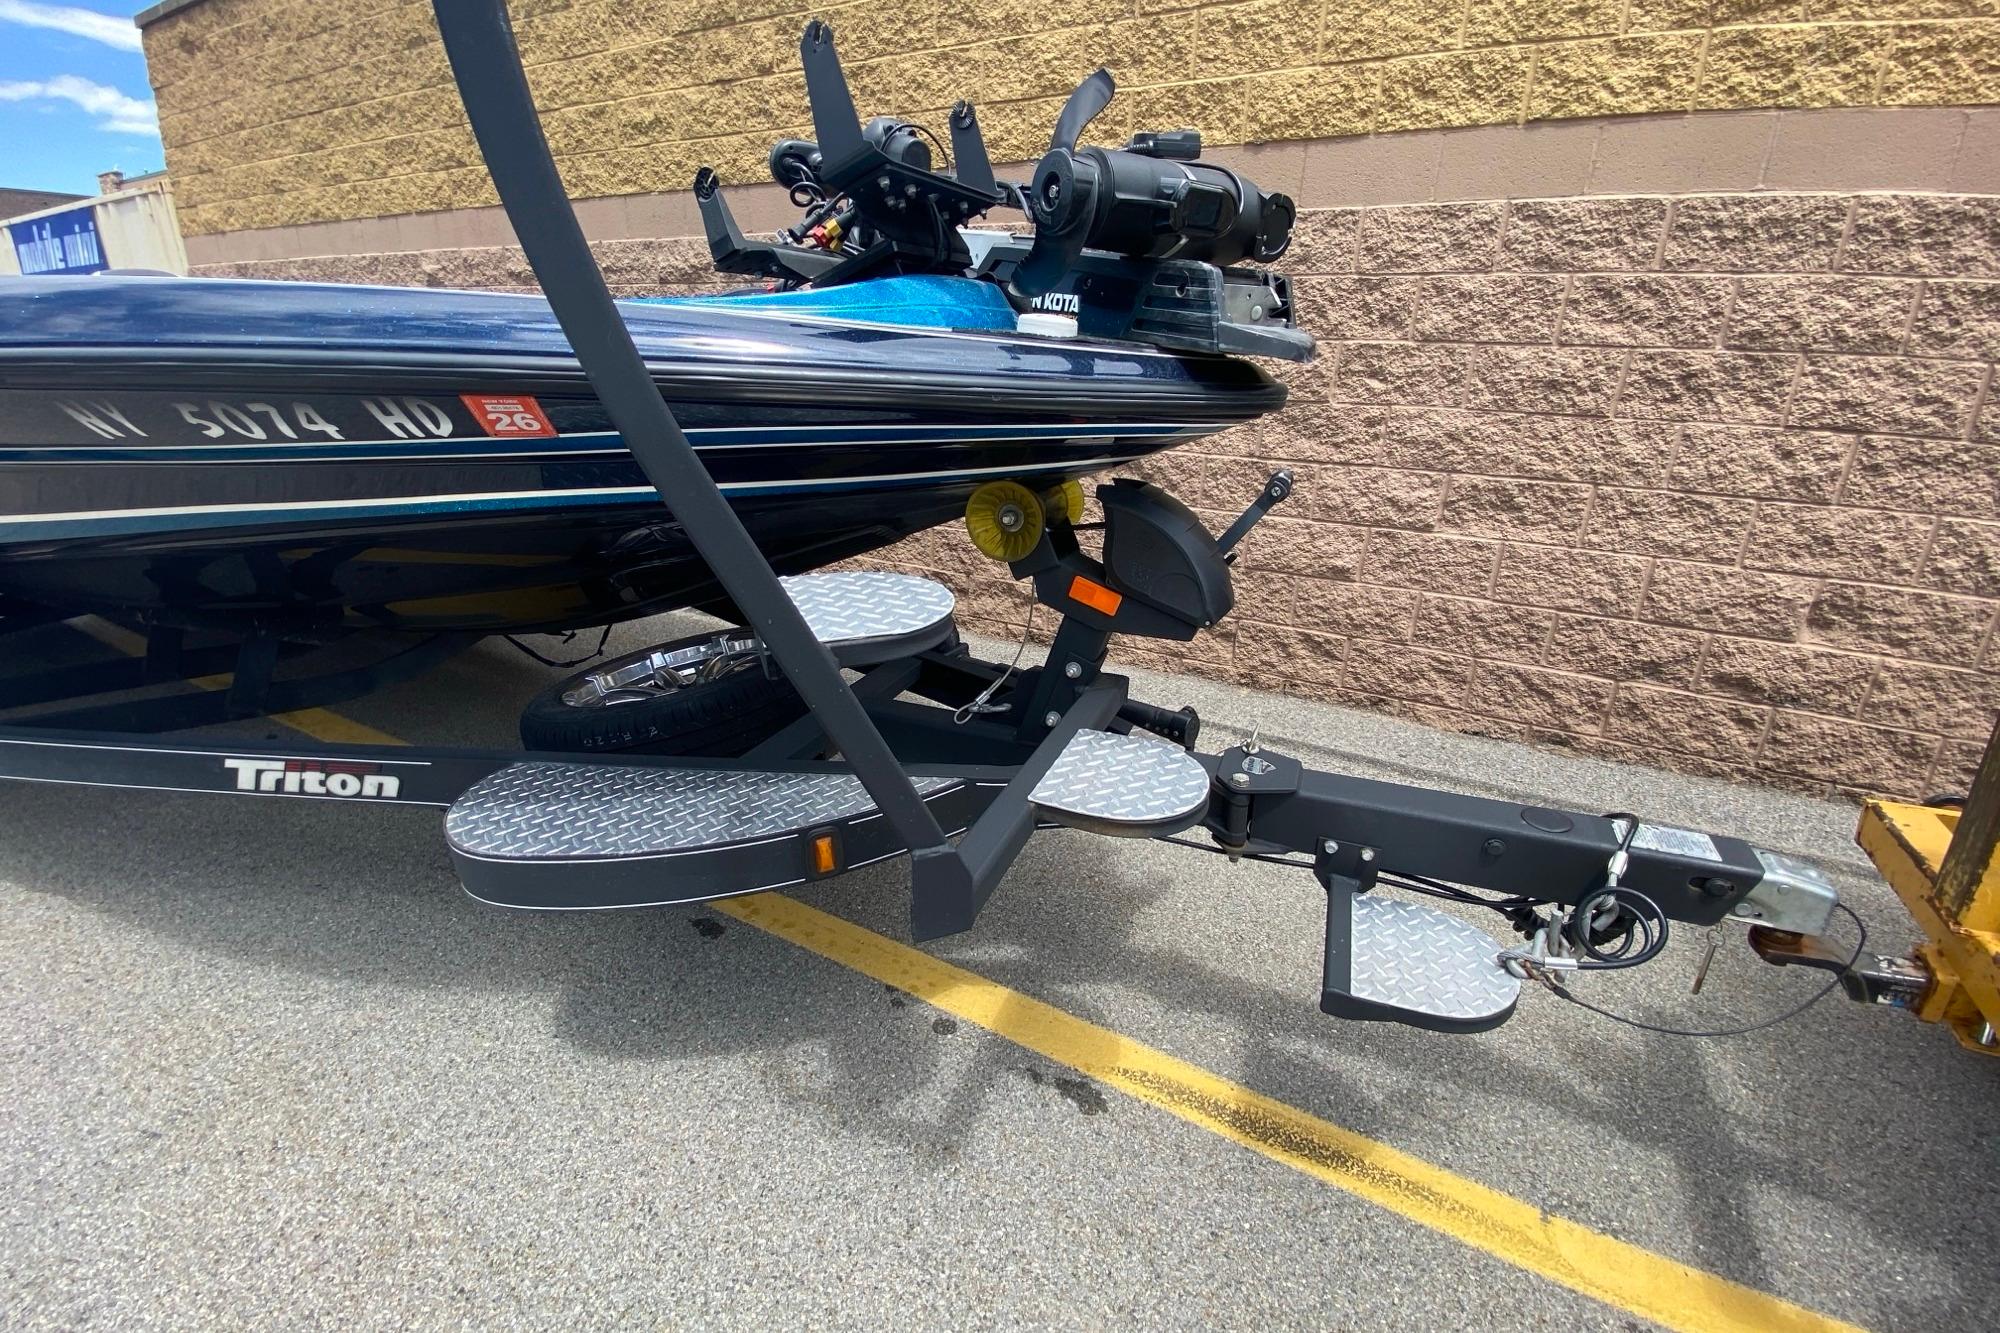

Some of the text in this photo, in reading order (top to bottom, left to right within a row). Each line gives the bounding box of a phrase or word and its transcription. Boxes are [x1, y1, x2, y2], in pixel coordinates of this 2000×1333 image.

[18, 221, 100, 274] mobile mini
[1030, 292, 1079, 313] N KOTA
[53, 398, 454, 440] NY 5074 HD
[486, 413, 541, 431] 26
[224, 758, 400, 798] Triton
